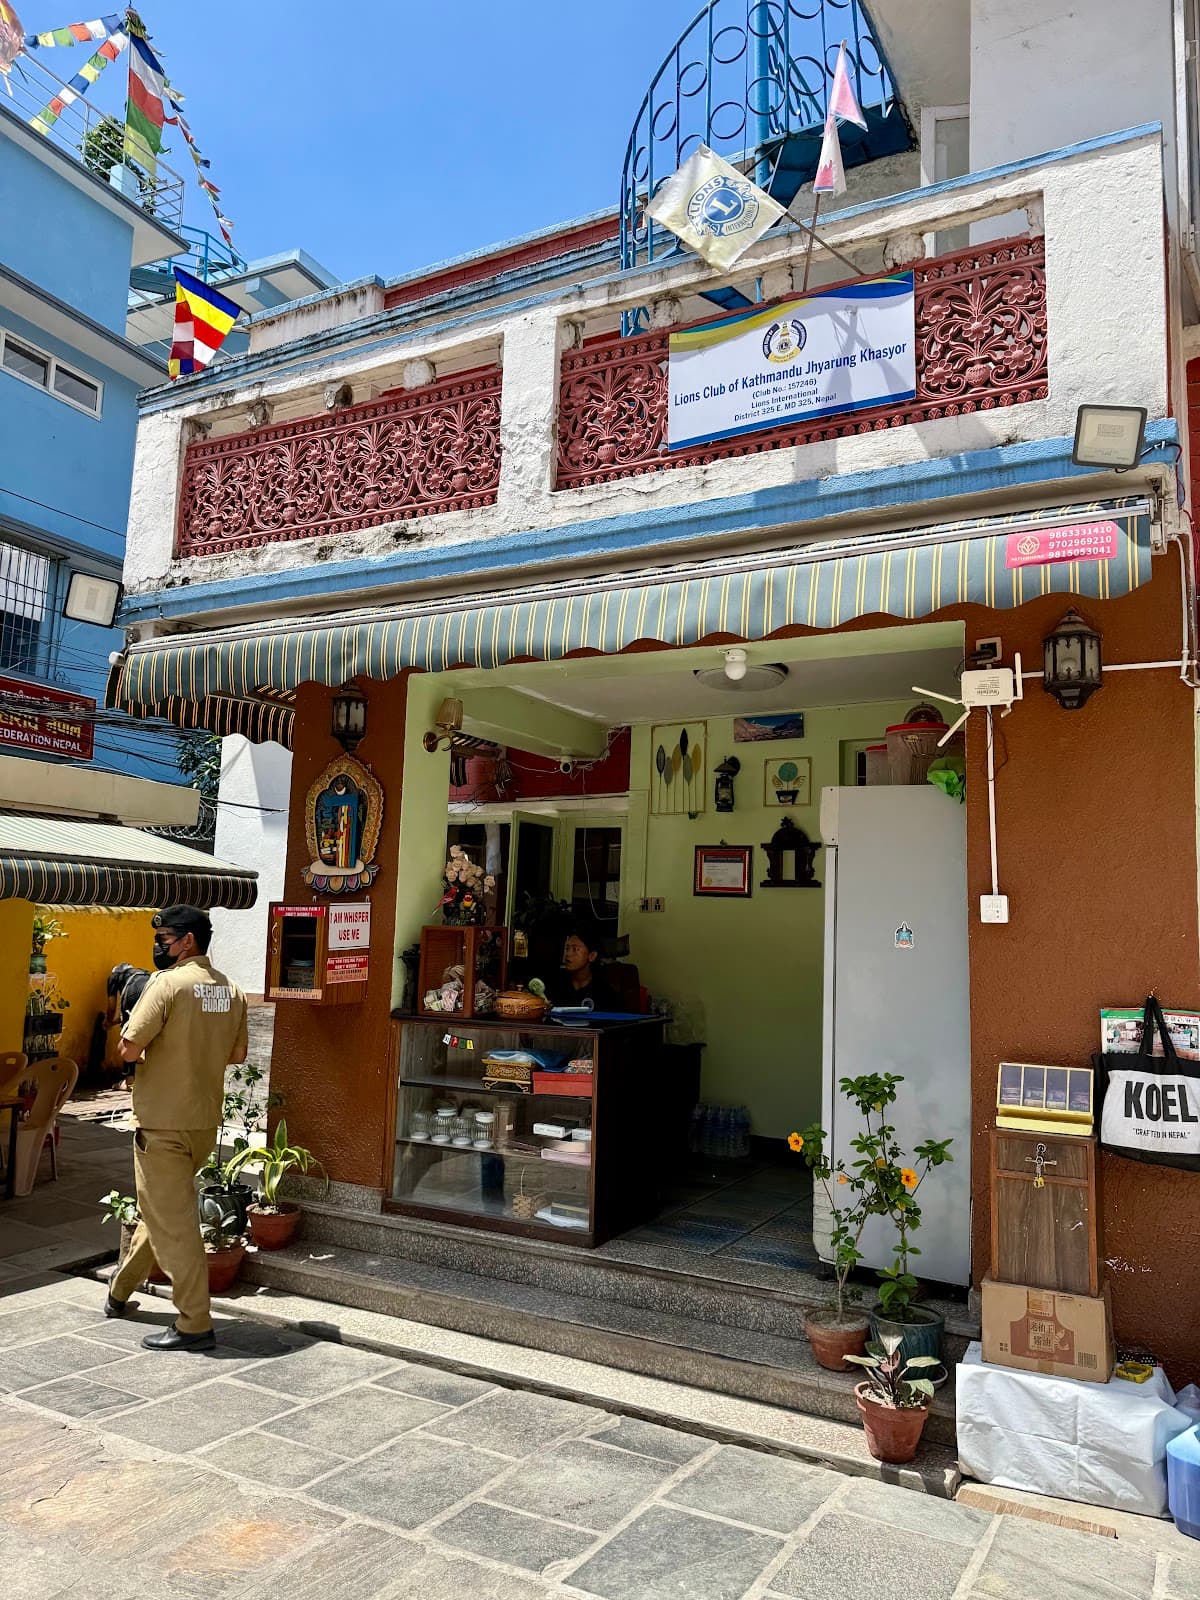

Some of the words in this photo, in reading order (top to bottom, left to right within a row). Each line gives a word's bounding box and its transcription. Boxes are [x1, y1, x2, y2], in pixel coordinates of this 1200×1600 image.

[690, 177, 721, 213] LIONS
[709, 197, 738, 216] L
[674, 391, 700, 407] Lions
[703, 384, 725, 399] Club
[729, 381, 740, 392] of
[742, 366, 802, 390] Kathmandu
[805, 355, 857, 376] Jhyarung
[860, 342, 907, 363] Khasyor
[751, 399, 769, 409] Lions
[771, 388, 818, 405] International
[752, 389, 770, 400] (Club
[734, 410, 760, 422] District
[761, 405, 775, 415] 325
[784, 401, 797, 410] MD
[815, 393, 837, 405] Nepal
[52, 738, 82, 752] NEPAL
[334, 912, 343, 924] AM
[343, 911, 369, 923] WHISPER
[338, 929, 350, 941] USE
[193, 984, 237, 999] SECURITY
[202, 998, 231, 1013] GUARD
[1124, 1080, 1199, 1123] KOEL
[1161, 1131, 1167, 1139] IN
